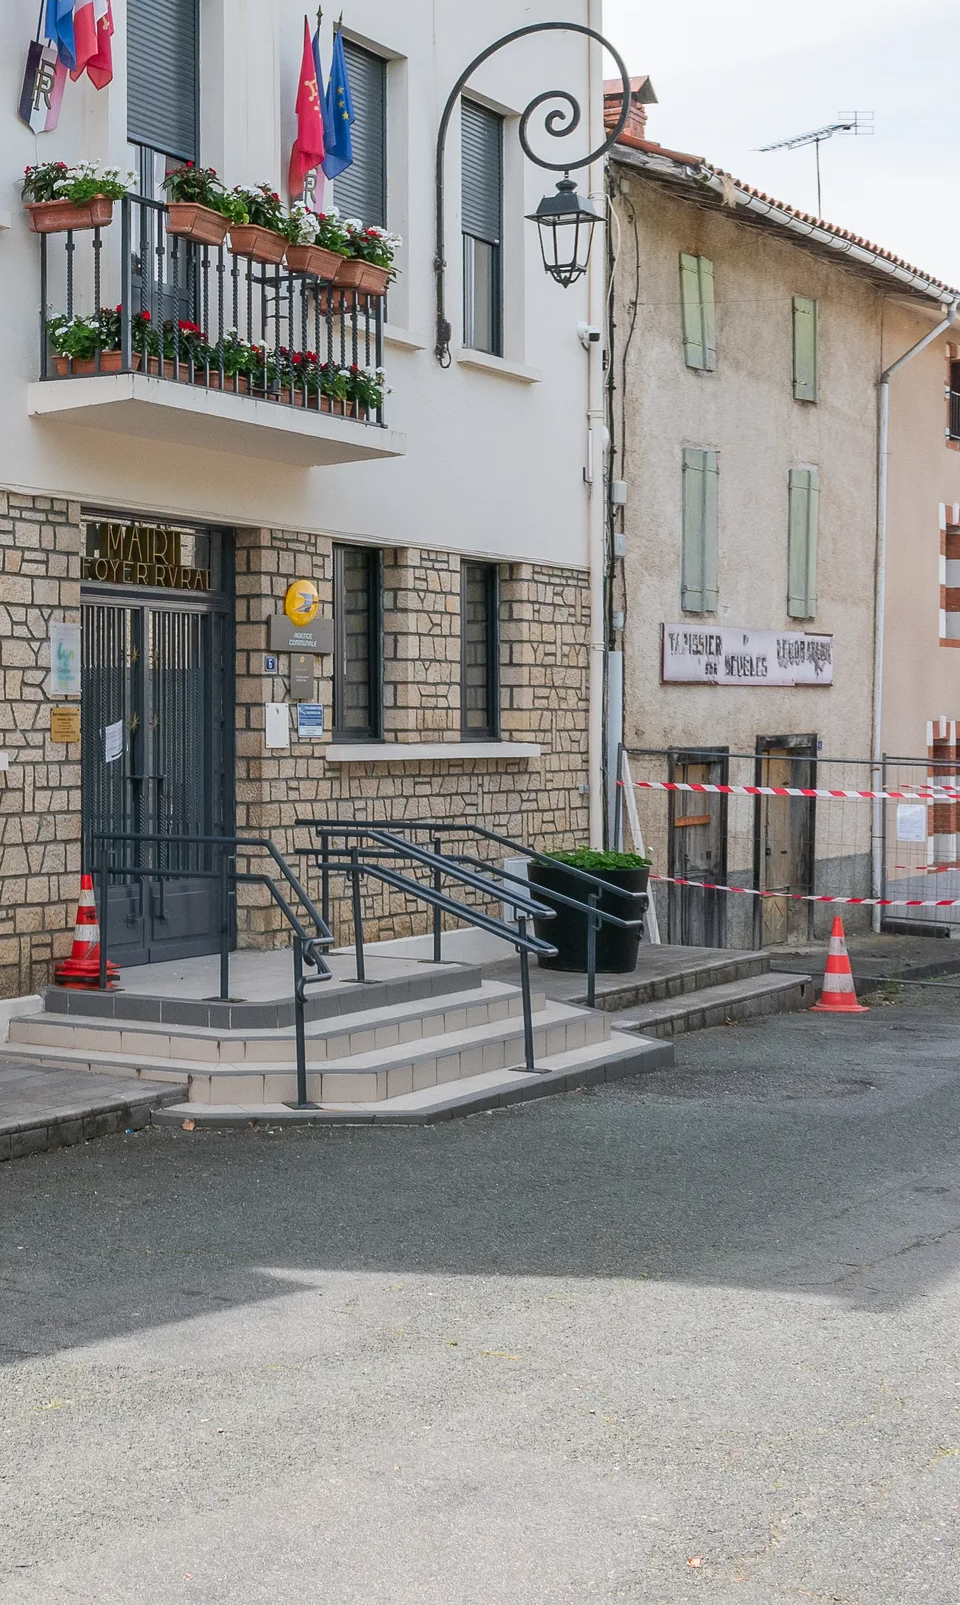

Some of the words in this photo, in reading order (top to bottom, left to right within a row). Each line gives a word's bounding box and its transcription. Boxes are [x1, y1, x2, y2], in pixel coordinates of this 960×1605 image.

[82, 557, 148, 585] FOYER
[293, 632, 313, 640] AGENCE
[288, 639, 318, 648] COMMUNALE
[268, 658, 274, 669] 6
